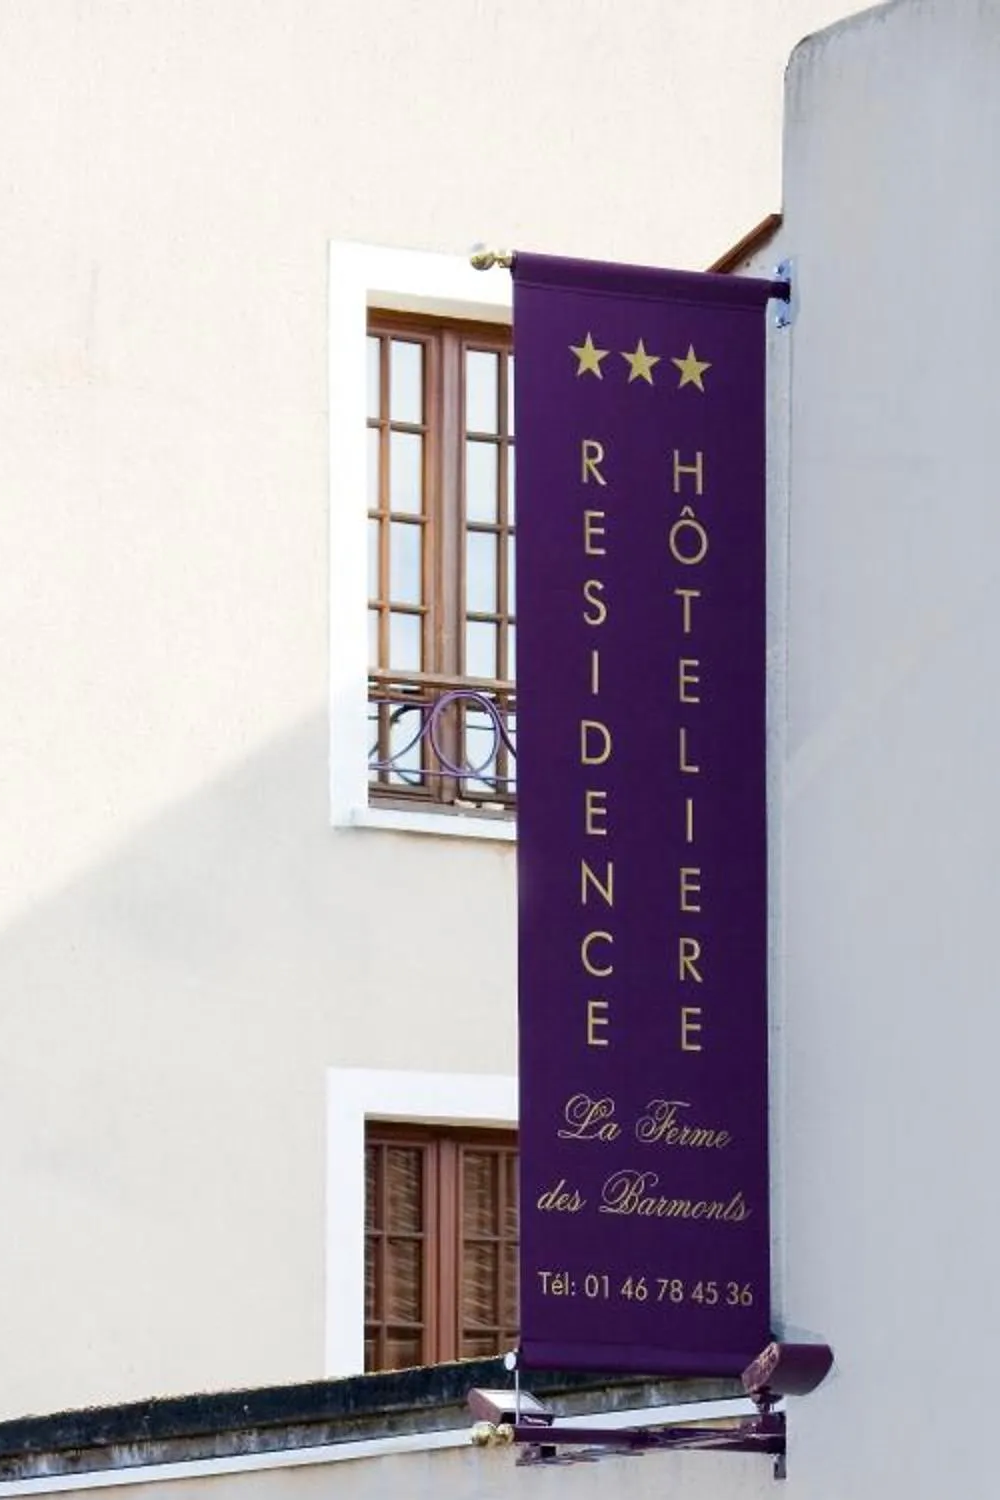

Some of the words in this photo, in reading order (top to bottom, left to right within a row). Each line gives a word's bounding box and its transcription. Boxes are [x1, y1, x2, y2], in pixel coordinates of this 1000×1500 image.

[579, 438, 616, 1046] RESIDENCE
[668, 448, 709, 1052] HÔTELIERE
[557, 1094, 621, 1141] La
[635, 1099, 732, 1149] Ferme
[537, 1179, 587, 1213] des
[599, 1169, 750, 1222] Barmonts
[537, 1271, 576, 1297] Tél:
[585, 1275, 610, 1298] 01
[621, 1277, 648, 1301] 46
[657, 1279, 684, 1303] 78
[691, 1281, 718, 1305] 45
[726, 1283, 753, 1306] 36
